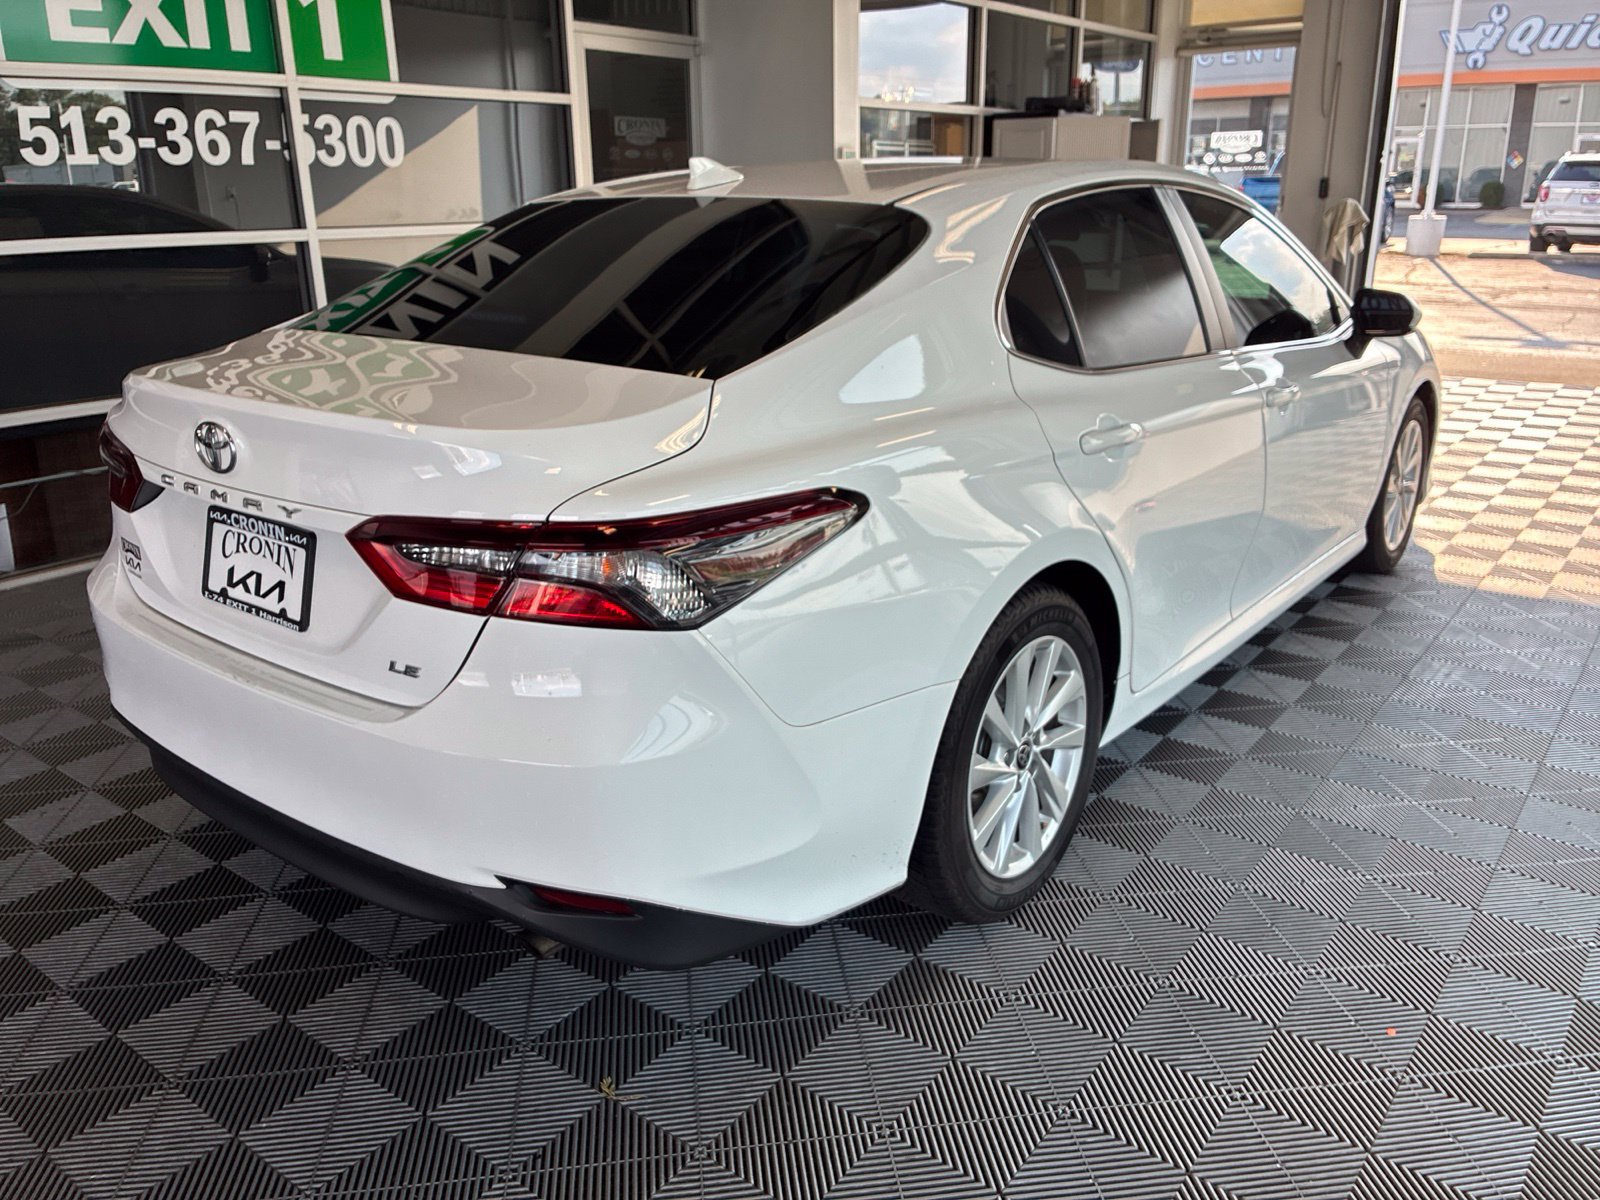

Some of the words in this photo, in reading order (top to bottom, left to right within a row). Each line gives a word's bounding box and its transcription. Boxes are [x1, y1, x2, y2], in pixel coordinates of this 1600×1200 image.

[301, 0, 344, 61] 1
[17, 105, 405, 168] 513-367-5300
[161, 474, 302, 519] CAMRY
[231, 513, 285, 540] CRONIN
[222, 529, 297, 579] CRONIN
[227, 565, 286, 604] KIA
[226, 599, 249, 612] EXIT
[251, 607, 257, 615] 1
[260, 611, 300, 632] Harrison
[389, 660, 422, 678] LE
